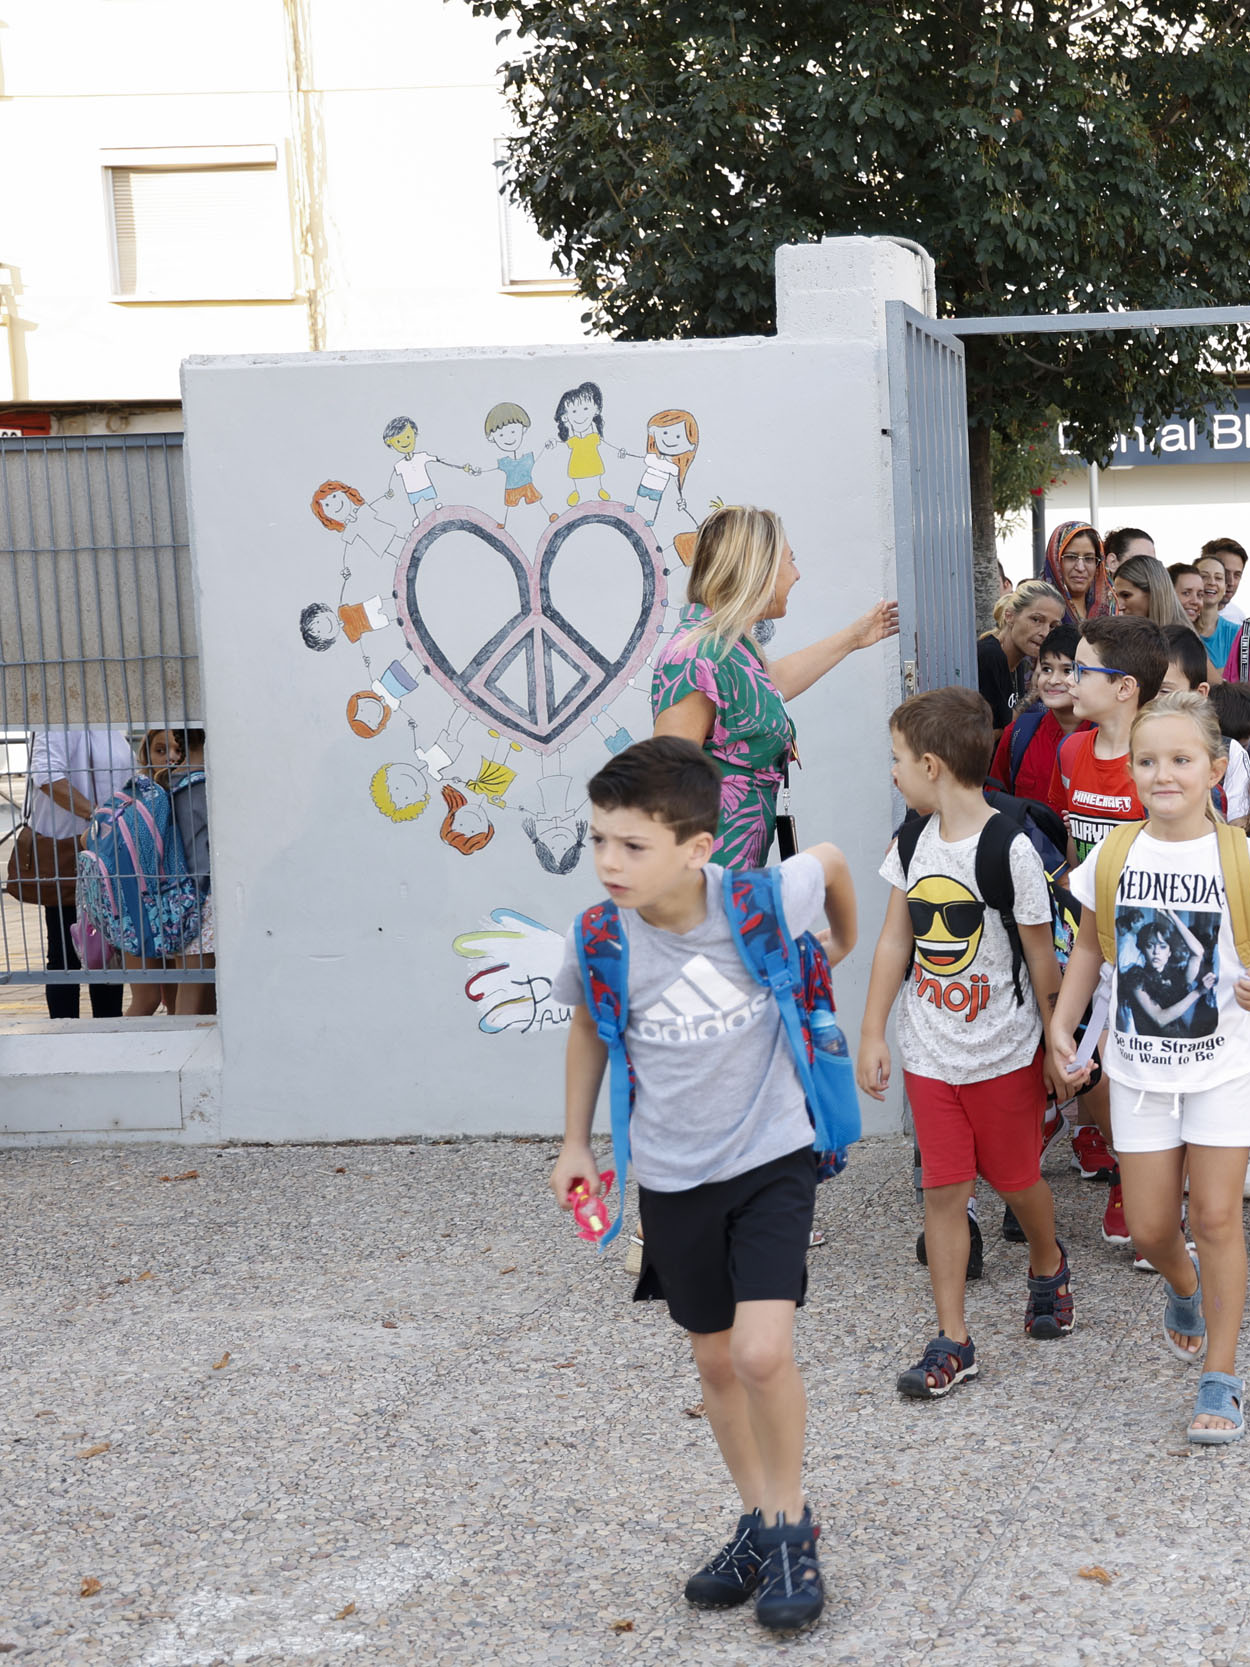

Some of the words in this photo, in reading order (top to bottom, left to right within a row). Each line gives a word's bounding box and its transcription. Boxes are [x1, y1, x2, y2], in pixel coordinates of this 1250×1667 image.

[1072, 789, 1132, 812] MINECRAFT
[1118, 865, 1225, 909] EDNESDA
[1129, 1036, 1153, 1052] the
[1160, 1035, 1225, 1054] Strange
[1139, 1053, 1172, 1065] Want
[1178, 1055, 1190, 1065] to
[1195, 1051, 1215, 1062] Be
